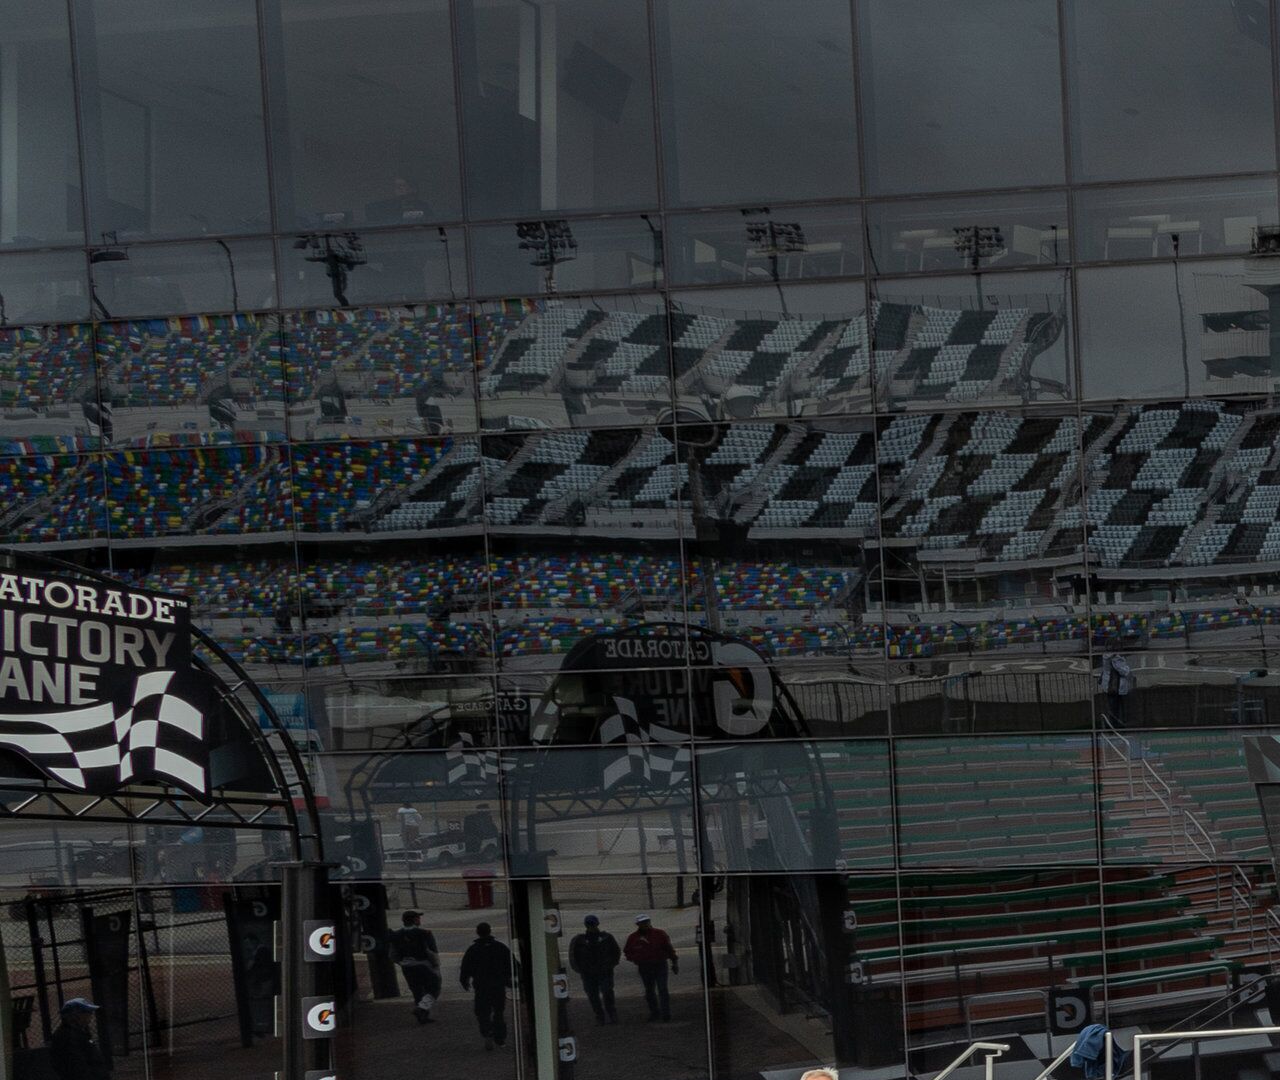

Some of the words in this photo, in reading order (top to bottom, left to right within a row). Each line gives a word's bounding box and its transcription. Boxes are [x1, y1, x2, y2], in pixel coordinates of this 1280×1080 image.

[3, 613, 176, 668] ICTORY
[0, 659, 100, 705] ANE
[309, 926, 336, 955] G
[307, 1001, 335, 1032] G
